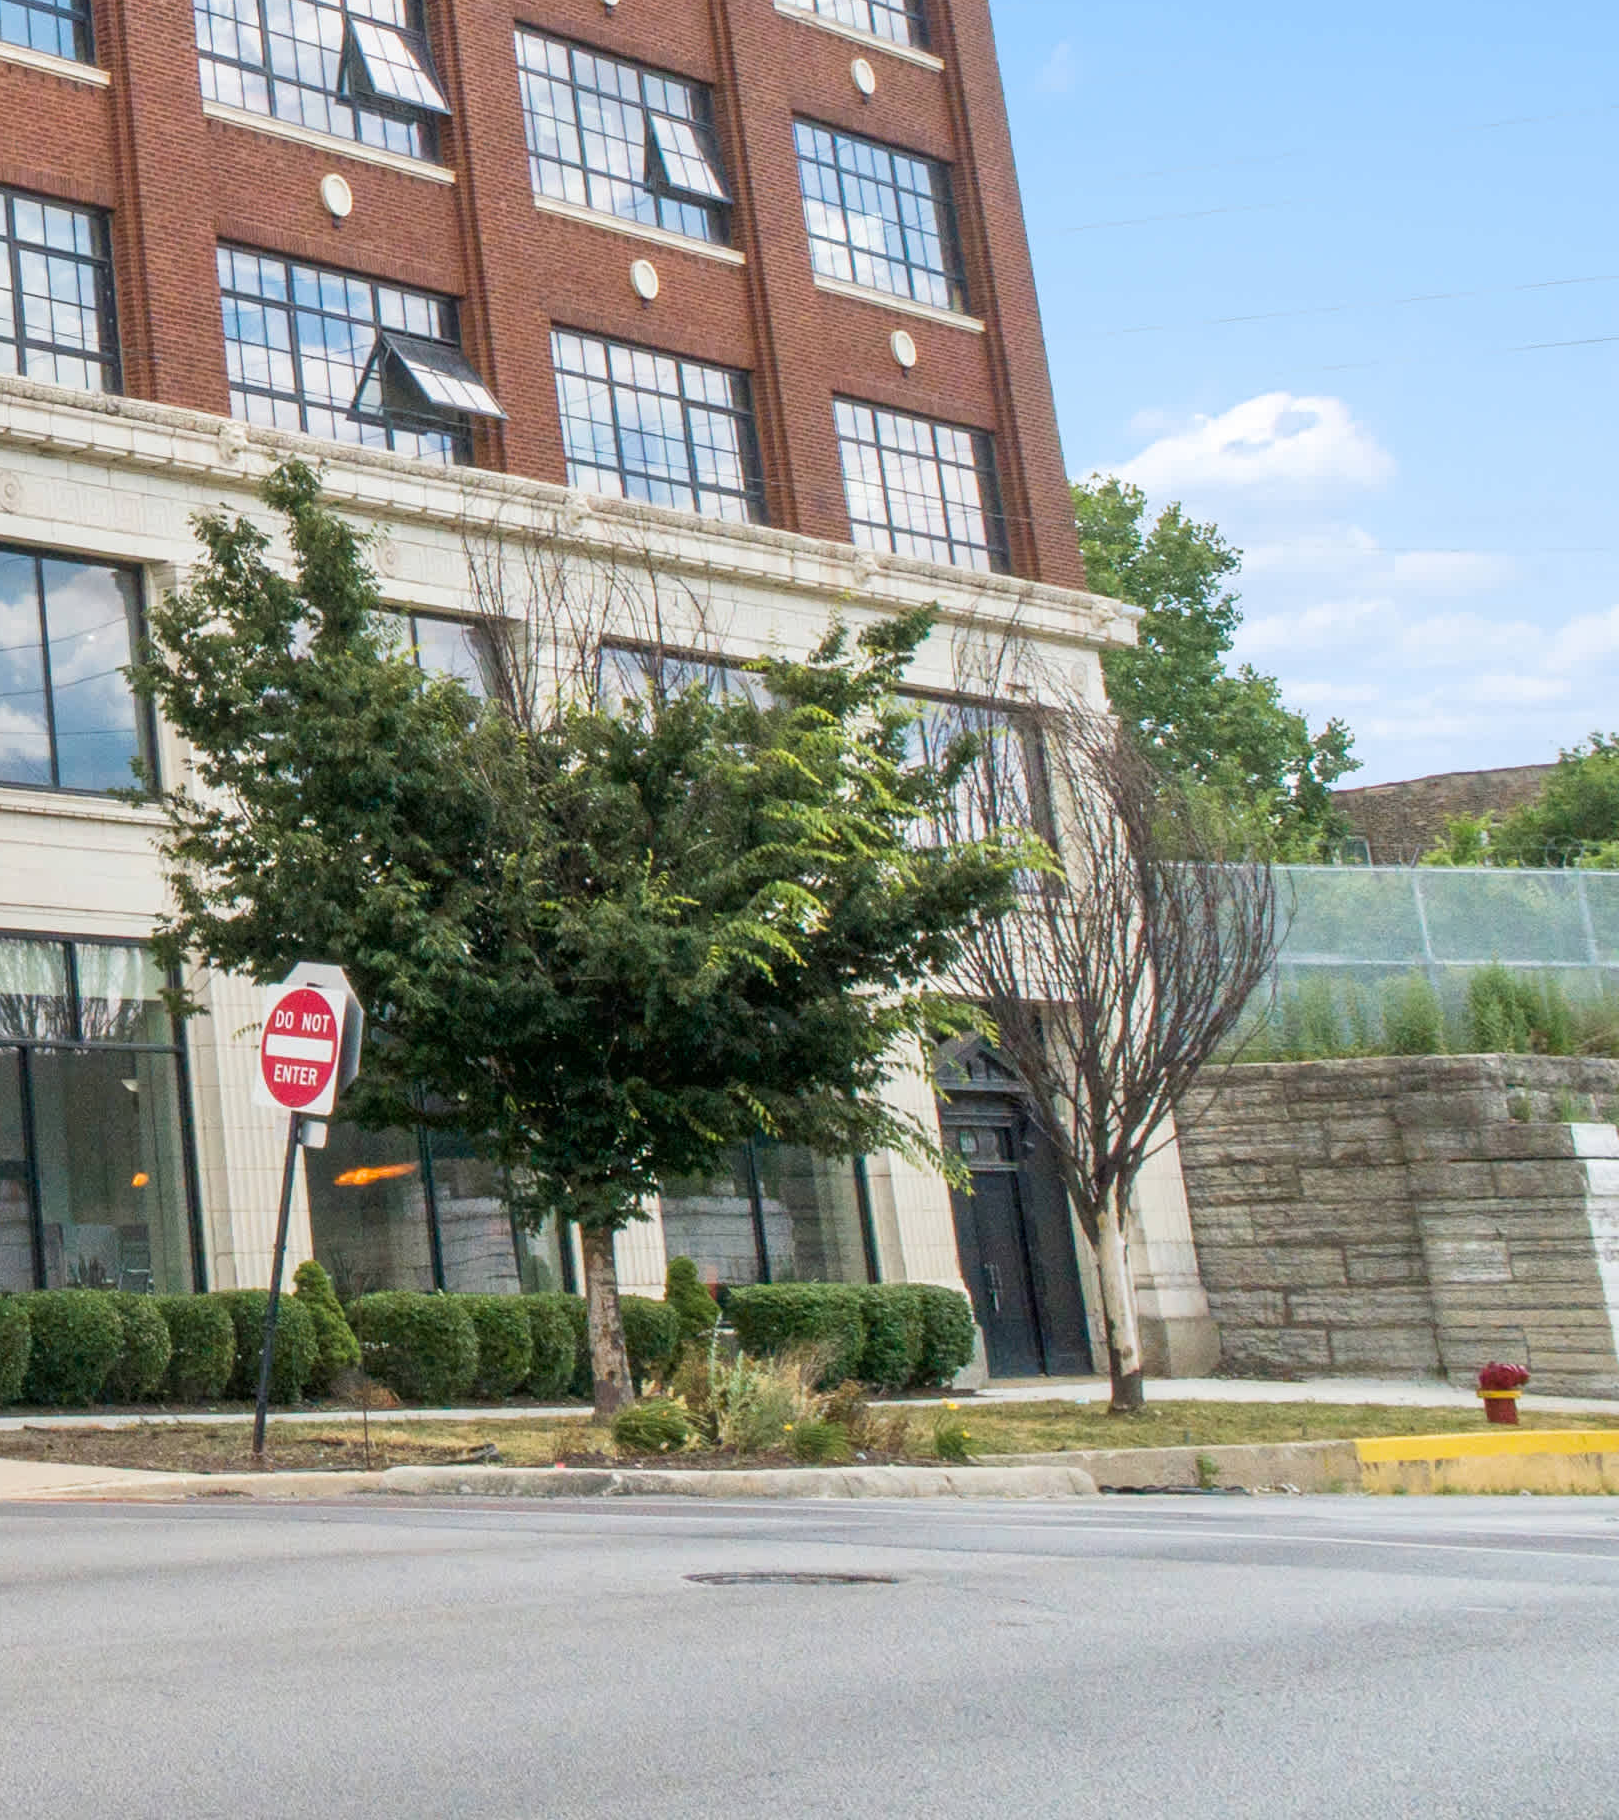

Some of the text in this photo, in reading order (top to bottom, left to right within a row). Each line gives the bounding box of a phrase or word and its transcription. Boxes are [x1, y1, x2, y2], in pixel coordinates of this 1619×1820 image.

[274, 1010, 331, 1033] DO NOT
[273, 1063, 318, 1086] ENTER
